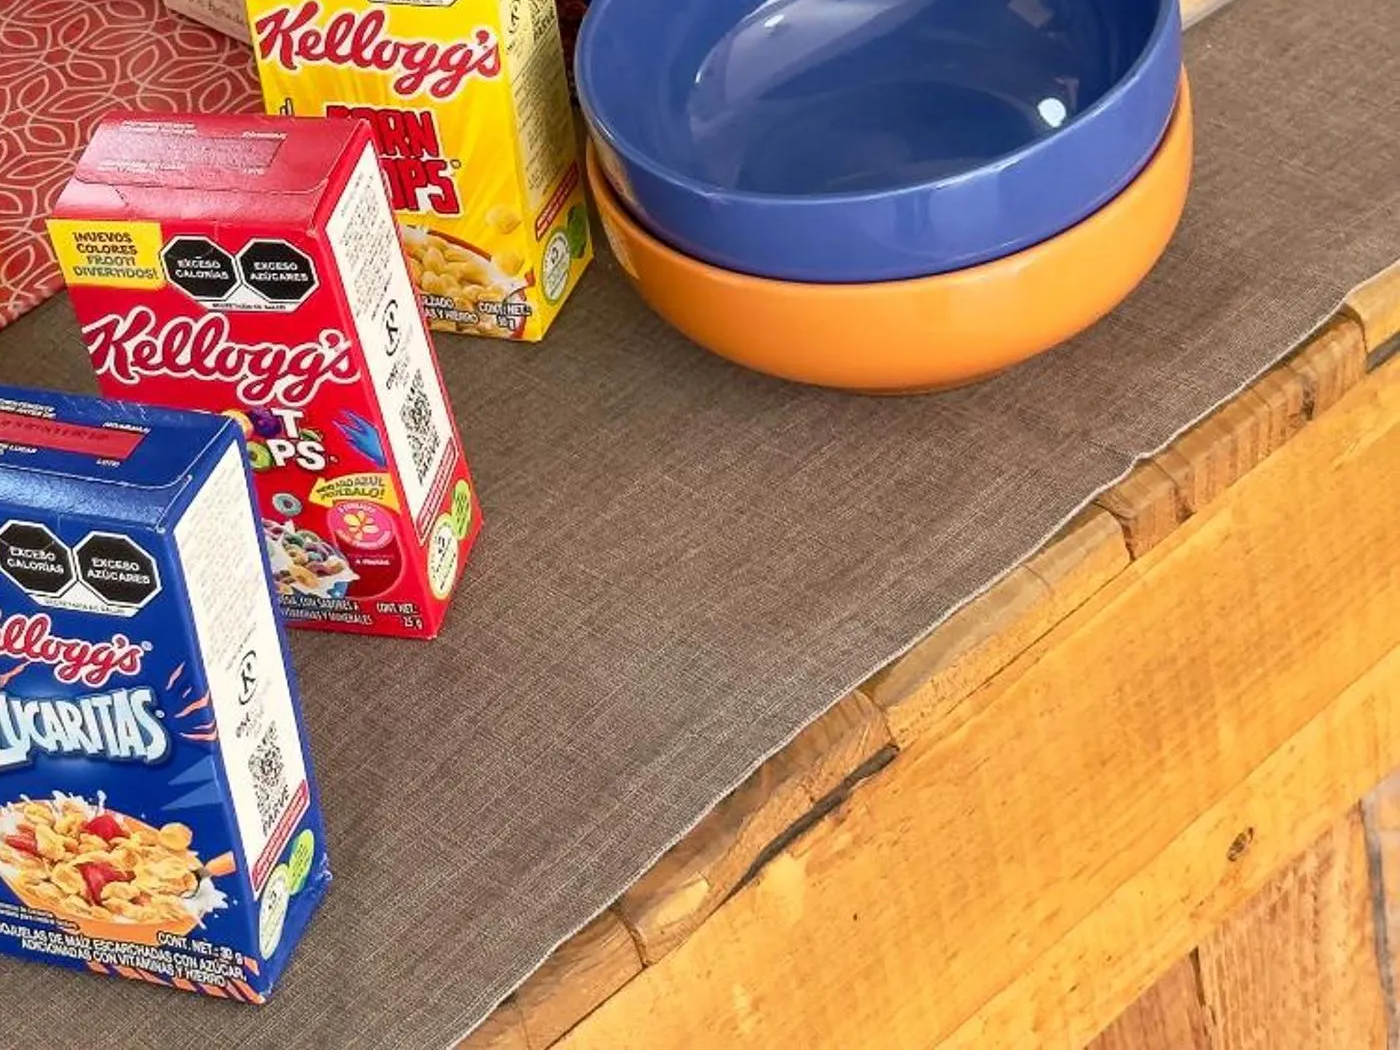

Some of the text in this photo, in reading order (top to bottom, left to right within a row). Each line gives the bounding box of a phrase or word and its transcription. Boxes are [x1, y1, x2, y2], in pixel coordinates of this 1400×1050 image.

[255, 1, 501, 98] Kellogg's
[76, 243, 137, 255] COLORES
[177, 259, 221, 269] EXCESO
[253, 261, 298, 271] EXCESO
[175, 269, 229, 280] CALORÍAS
[250, 271, 309, 282] AZÚCARES
[83, 307, 361, 404] Kellogg's
[8, 545, 57, 562] EXCESO
[6, 557, 65, 575] CALORÍAS
[90, 556, 141, 572] EXCESO
[87, 568, 151, 585] AZÚCARES
[21, 938, 91, 961] ADICIONADAS
[93, 950, 117, 964] CON
[119, 953, 174, 976] VITAMINAS
[175, 964, 184, 977] Y
[48, 931, 64, 944] DE
[93, 938, 173, 964] ESCARCHADAS
[173, 953, 198, 967] CON
